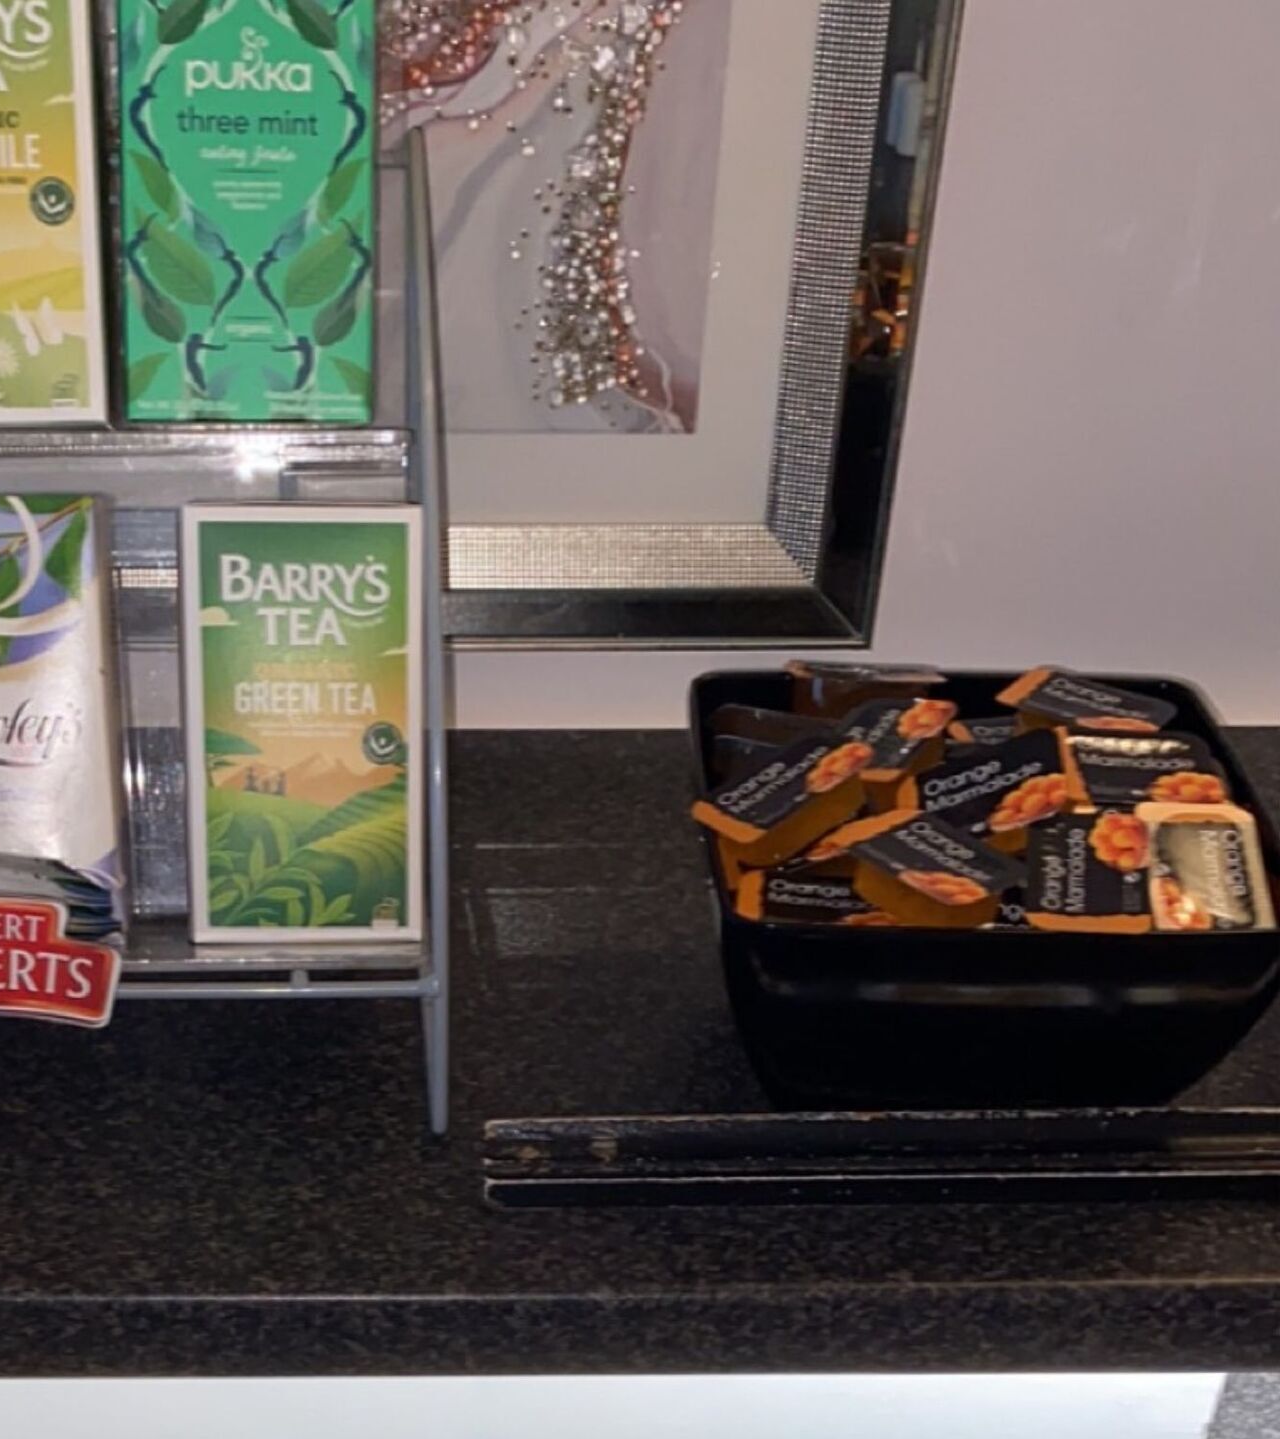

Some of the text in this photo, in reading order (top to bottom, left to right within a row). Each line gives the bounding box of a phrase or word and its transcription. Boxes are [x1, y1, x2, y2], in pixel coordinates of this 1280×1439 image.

[184, 58, 314, 97] pukka
[175, 105, 320, 137] three mint
[219, 553, 391, 617] BARRY'S
[258, 607, 348, 646] TEA
[234, 681, 377, 717] GREEN TEA
[924, 761, 1002, 796] Orange
[1077, 752, 1196, 771] Marmalade
[717, 761, 787, 806] Orange
[925, 762, 1043, 812] Marmalade
[908, 821, 976, 861] Orange
[768, 878, 851, 898] Orange
[1064, 827, 1087, 913] Marmalade
